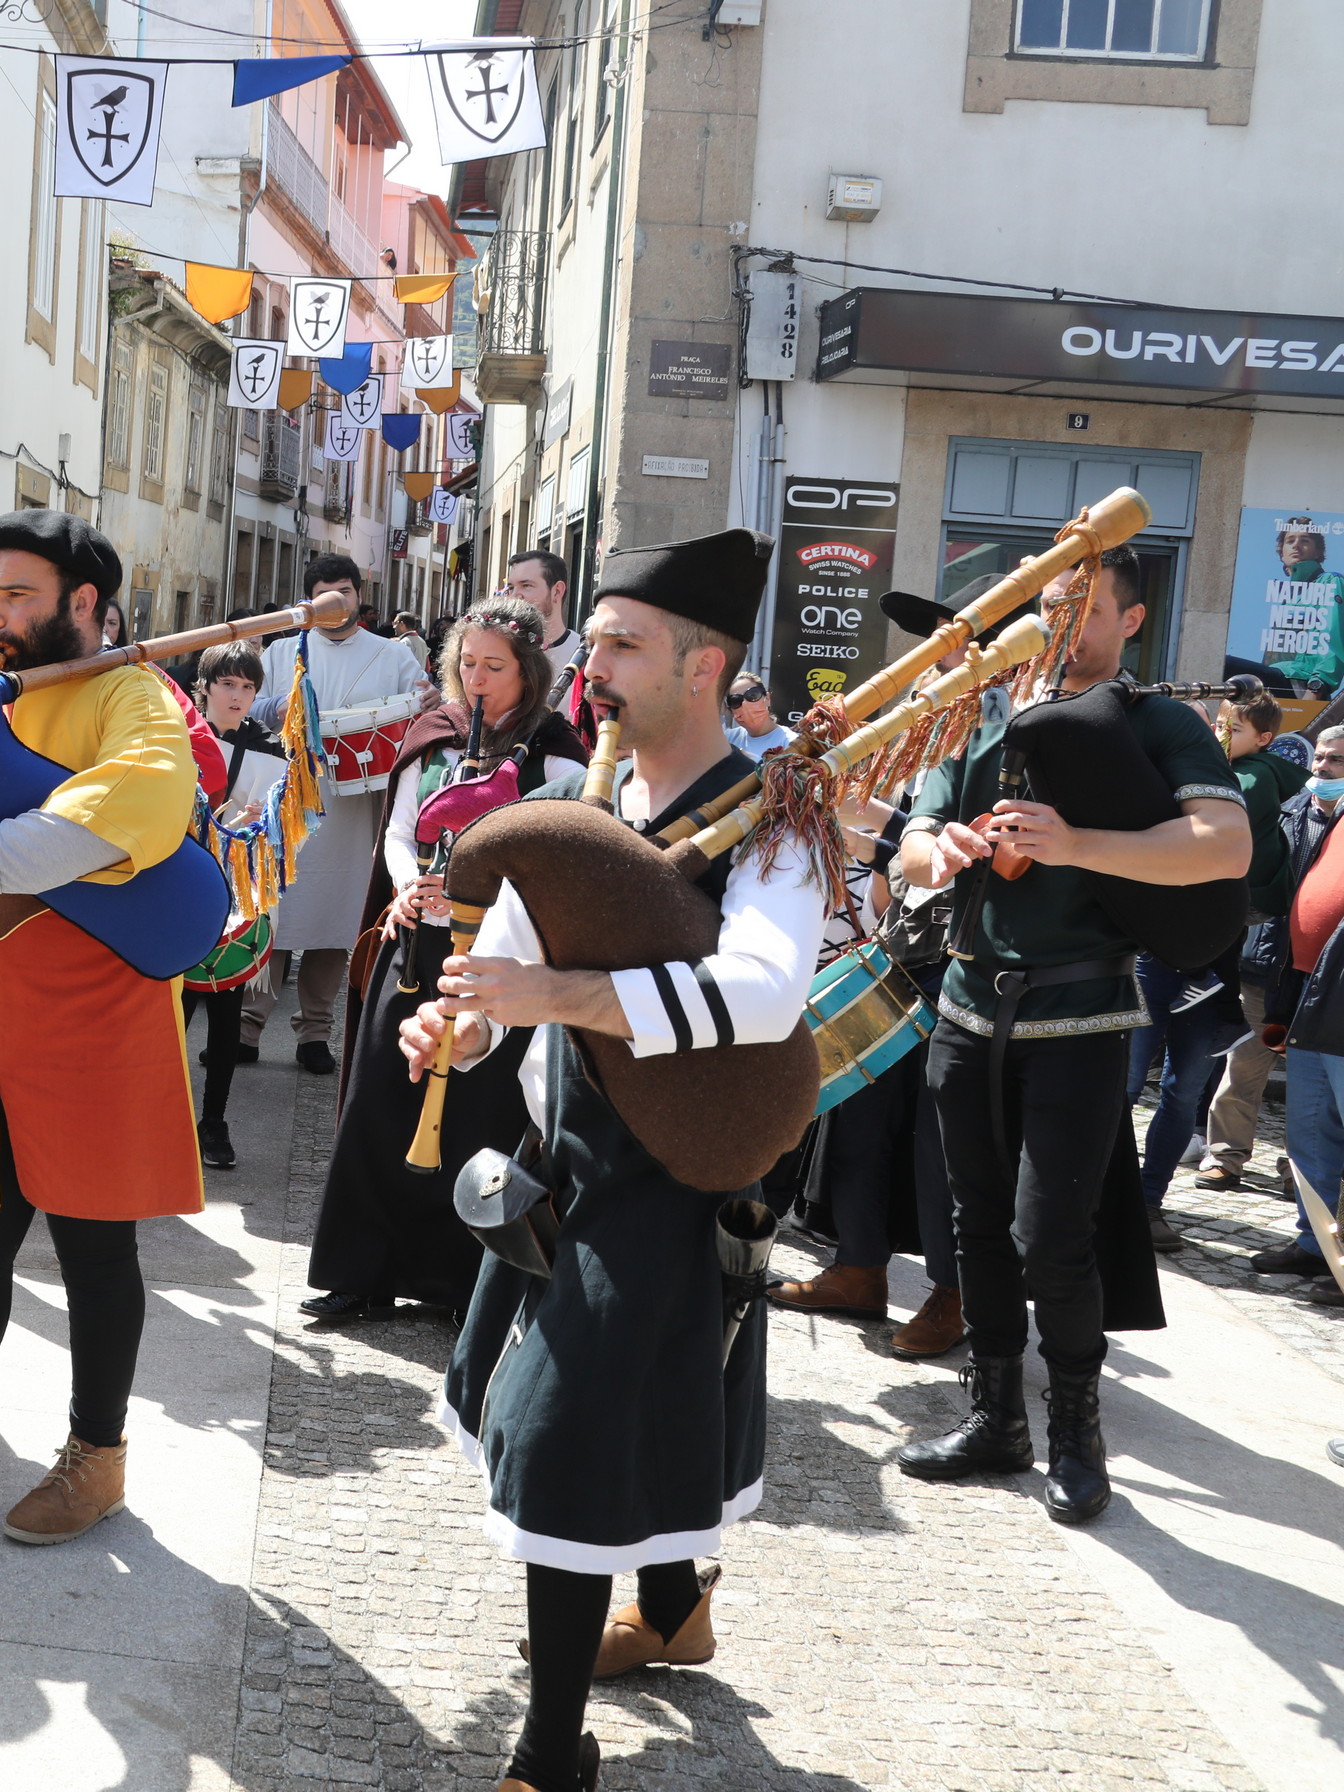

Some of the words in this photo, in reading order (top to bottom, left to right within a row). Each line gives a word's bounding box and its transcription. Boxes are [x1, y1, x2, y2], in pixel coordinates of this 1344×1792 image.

[680, 355, 701, 364] PRAÇA
[650, 372, 686, 382] ANTÓNIO
[691, 375, 728, 385] MEIRELES
[668, 366, 712, 376] FRANCISCO
[1074, 415, 1083, 428] 9
[786, 485, 897, 510] OP
[1274, 518, 1331, 535] Timberland
[393, 529, 408, 552] ELITE
[801, 545, 870, 567] CERTINA
[808, 560, 831, 571] SWISS
[831, 560, 862, 575] WATCHES
[798, 584, 869, 598] POLICE
[1265, 580, 1337, 606] NATURE
[800, 605, 862, 629] one
[1269, 605, 1329, 631] NEEDS
[826, 629, 859, 637] Company
[1260, 628, 1331, 655] HEROES
[797, 643, 860, 659] SEIKO
